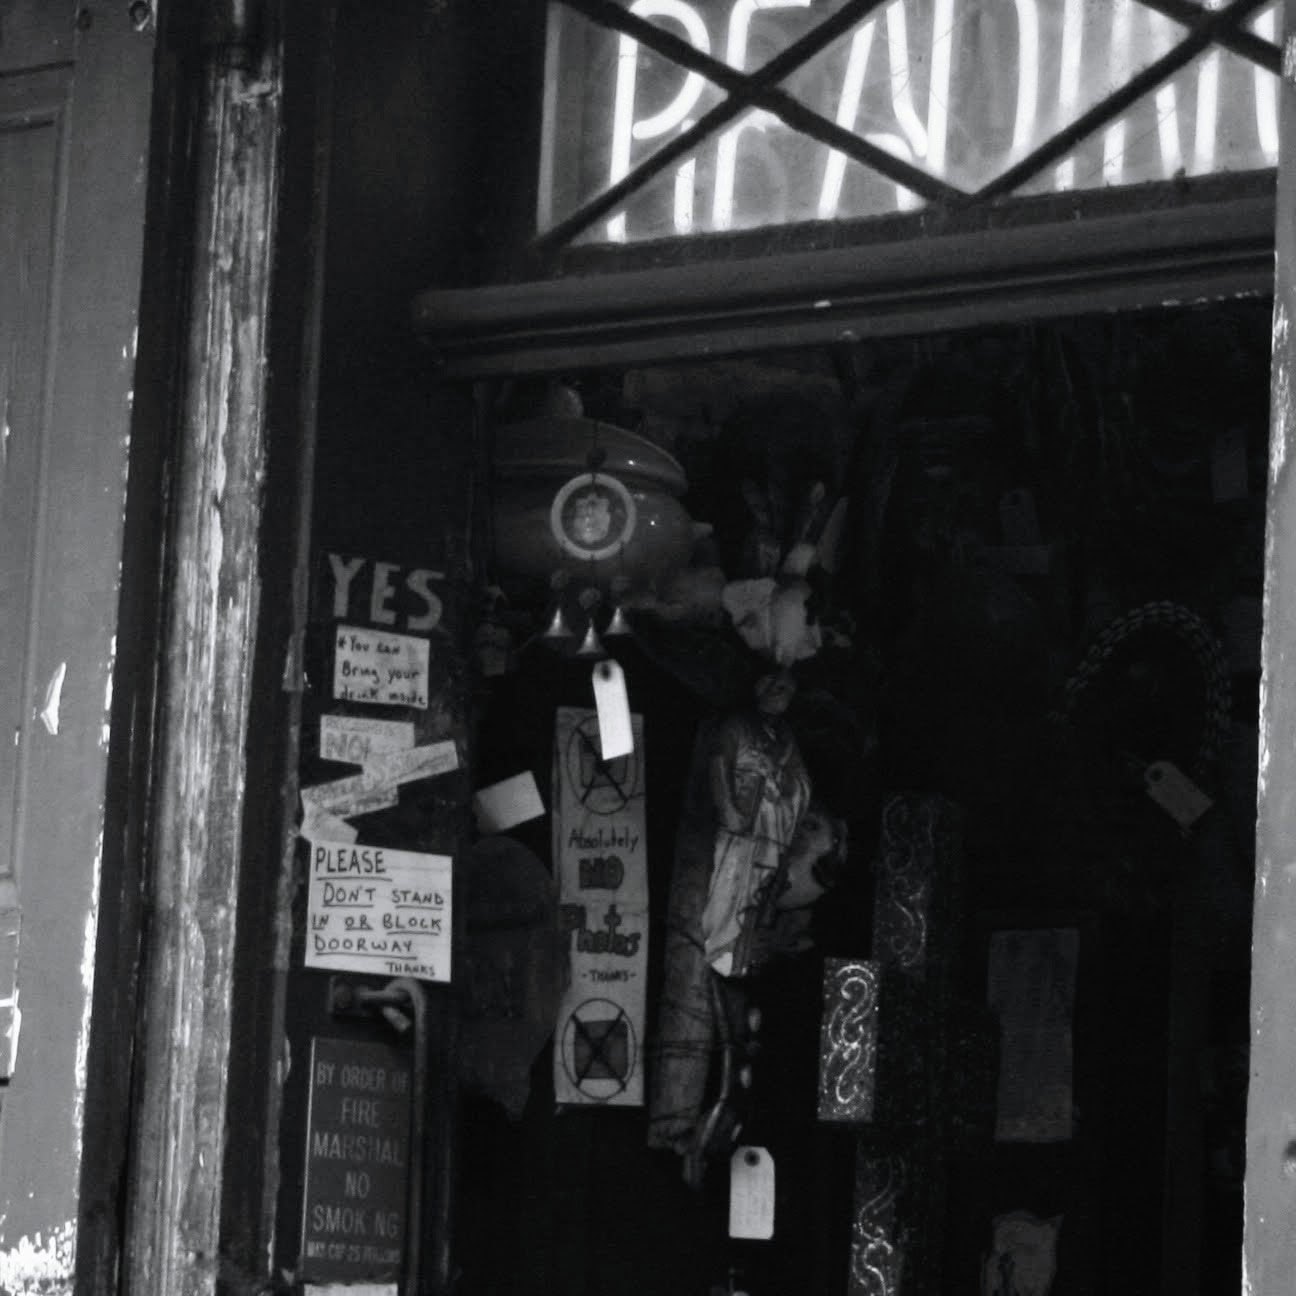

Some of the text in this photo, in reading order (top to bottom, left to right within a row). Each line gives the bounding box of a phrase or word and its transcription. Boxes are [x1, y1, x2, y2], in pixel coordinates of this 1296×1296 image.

[328, 553, 445, 631] YES
[568, 826, 640, 853] Absolutely
[315, 847, 386, 874] PLEASE
[578, 856, 624, 890] NO
[324, 882, 444, 905] DON'T STAND
[312, 913, 441, 931] IN OR BLOCK
[315, 935, 412, 953] DOORWAY
[385, 961, 435, 977] THANKS
[317, 1061, 335, 1085] BY
[341, 1064, 386, 1091] ORDER
[340, 1096, 380, 1128] FIRE
[313, 1130, 404, 1166] MARSHAL
[345, 1170, 370, 1198] NO
[312, 1204, 400, 1238] SMOKNG
